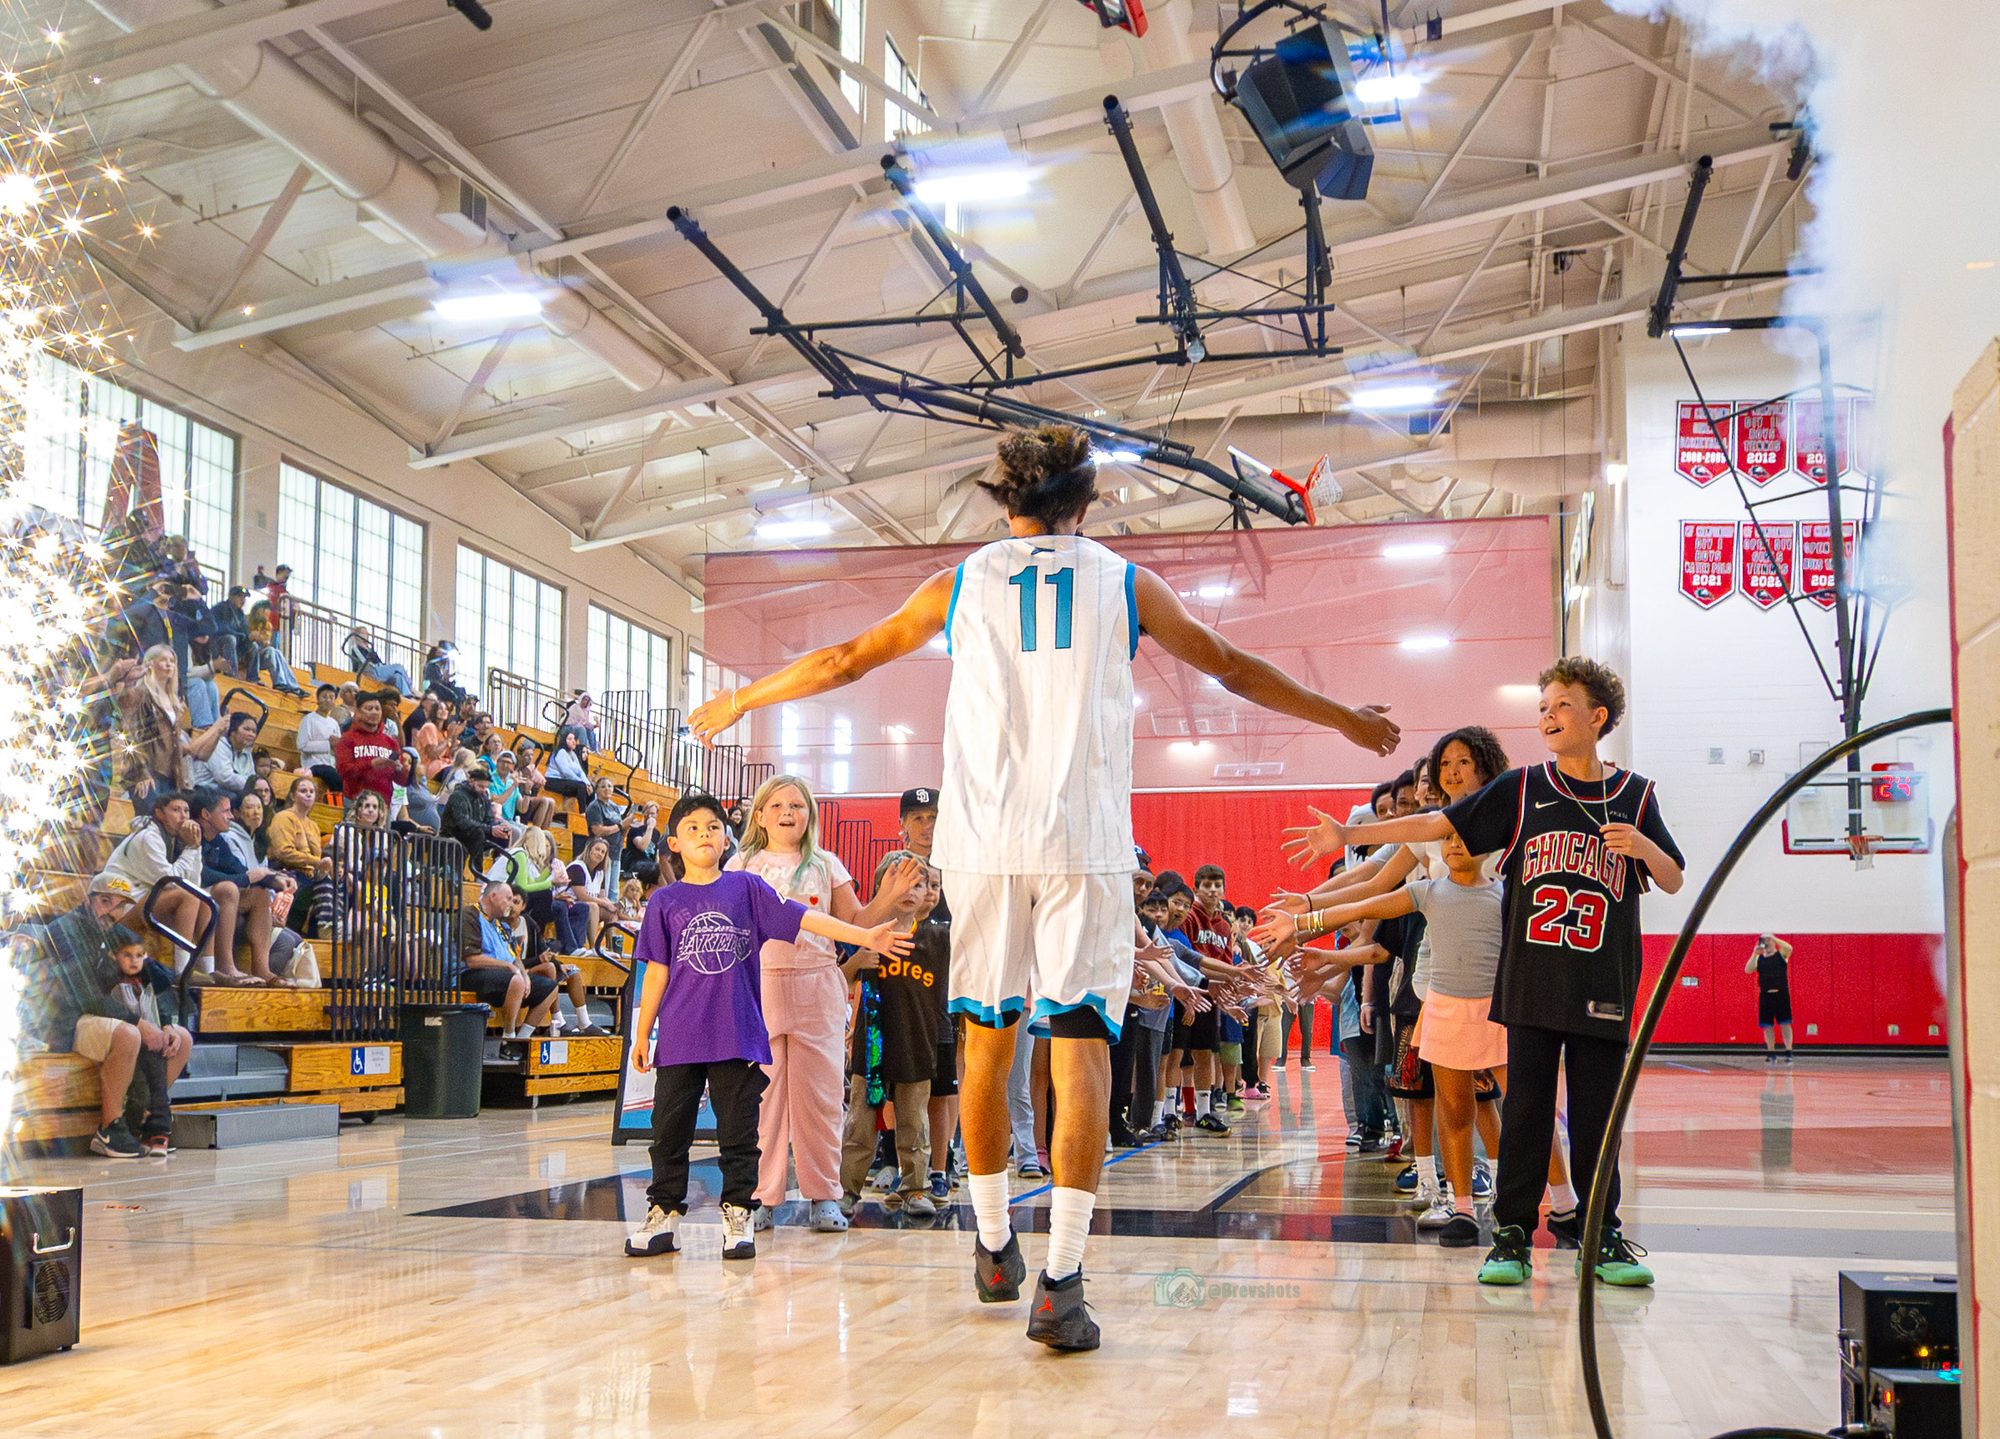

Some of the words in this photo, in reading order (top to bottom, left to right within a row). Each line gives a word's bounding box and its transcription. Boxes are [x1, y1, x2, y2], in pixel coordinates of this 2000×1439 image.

[1746, 452, 1777, 464] 2012
[1746, 562, 1789, 575] TENNS
[1692, 574, 1722, 586] 2021
[1811, 575, 1835, 587] 202
[1009, 565, 1074, 653] 11
[1522, 829, 1627, 904] CHICAGO
[1526, 884, 1609, 953] 23
